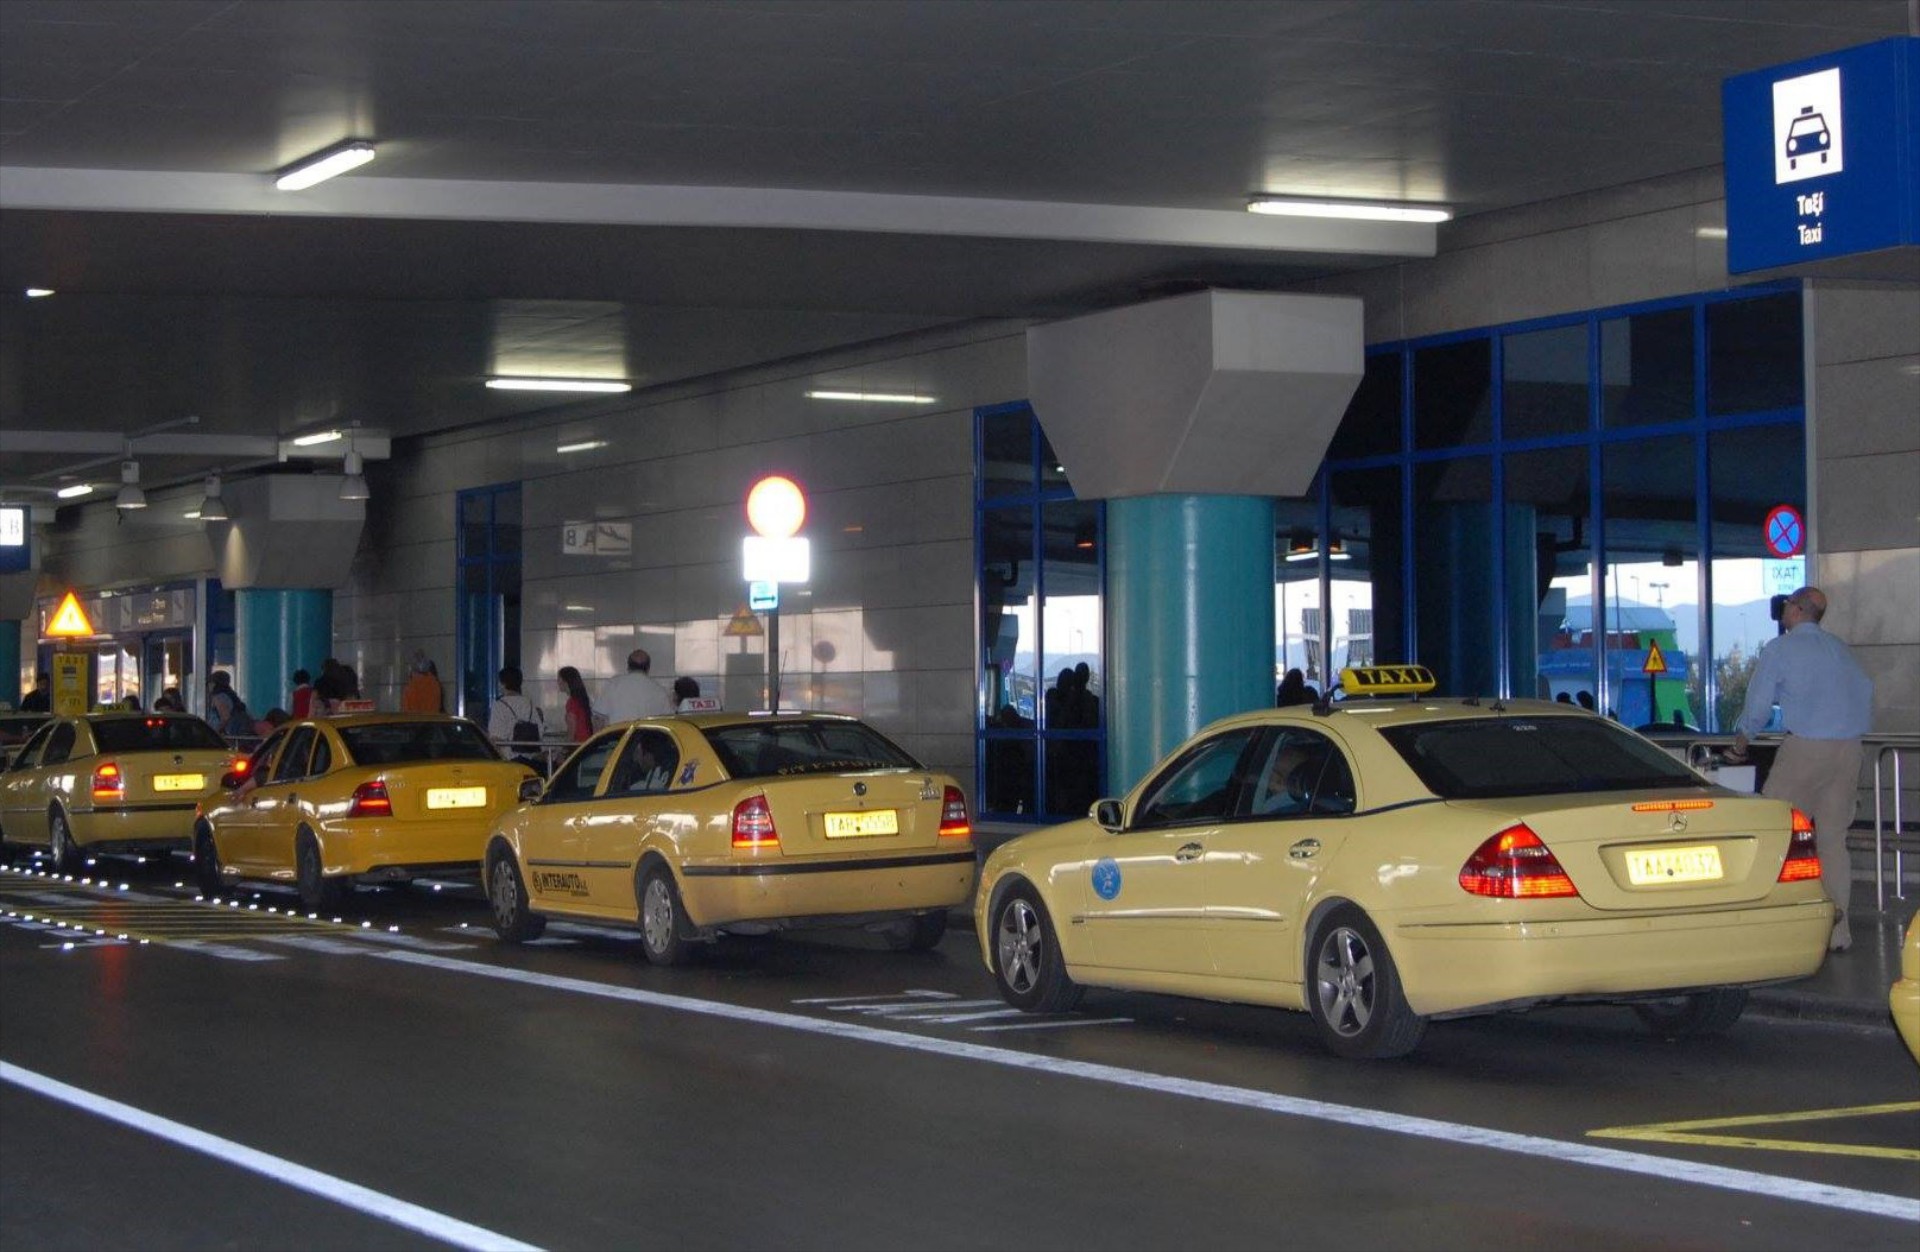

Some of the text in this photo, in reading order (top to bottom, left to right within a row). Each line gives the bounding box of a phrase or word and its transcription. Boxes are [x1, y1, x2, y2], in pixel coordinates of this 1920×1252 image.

[1796, 191, 1824, 217] Ταξί
[1798, 223, 1822, 245] Taxi
[1362, 668, 1422, 684] TAXI
[688, 699, 716, 709] TAXI
[541, 872, 580, 890] INTERAUTO
